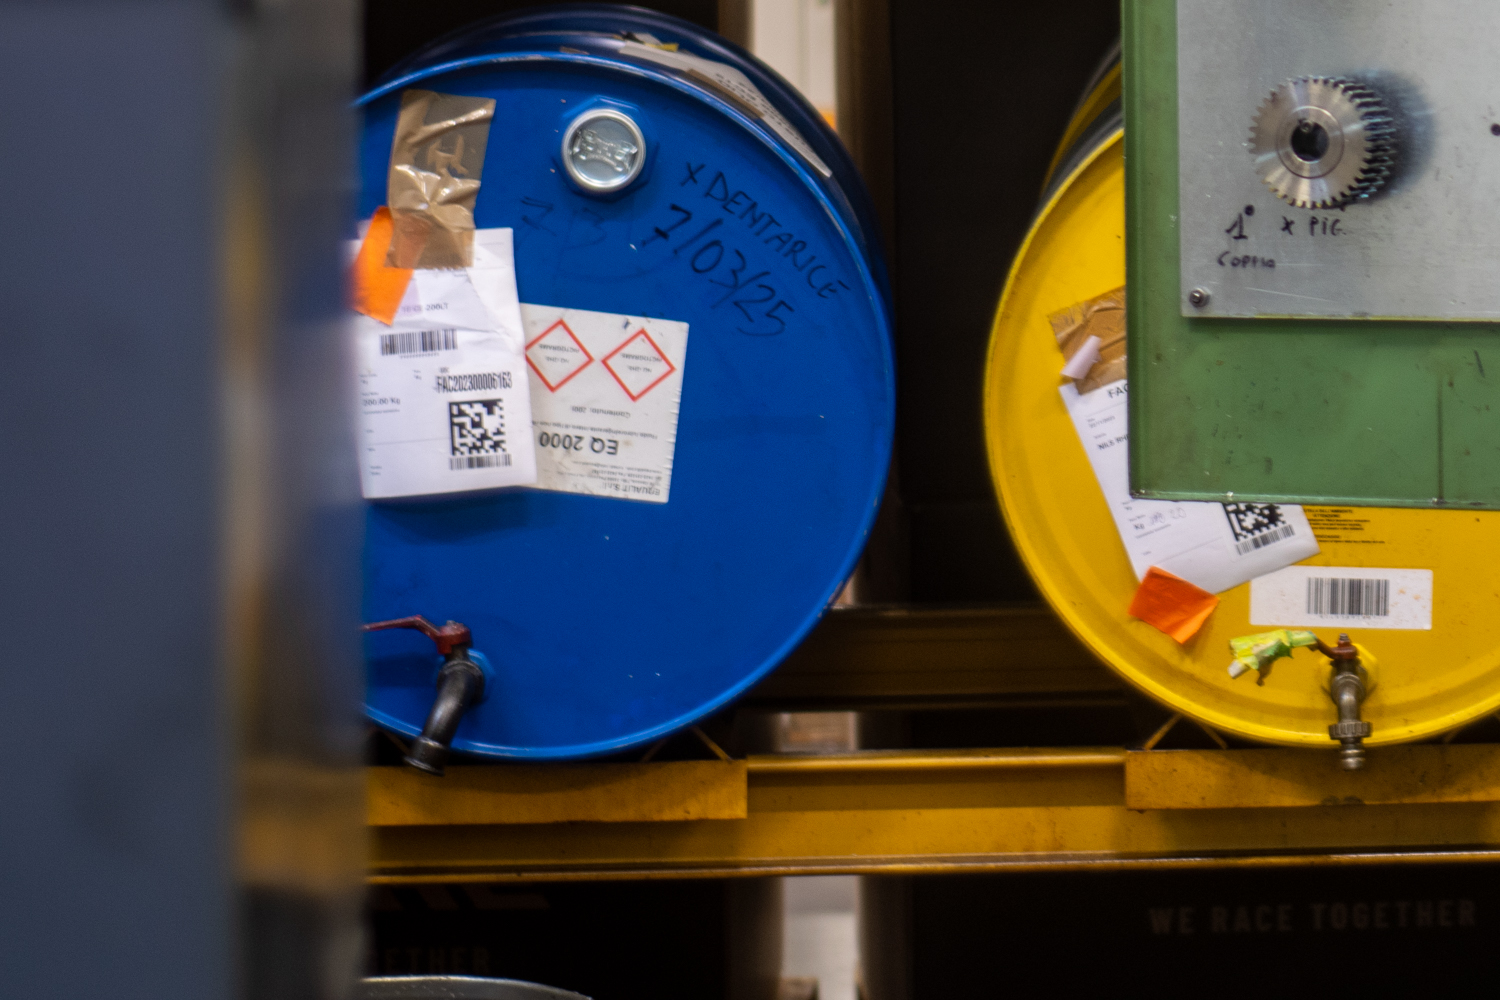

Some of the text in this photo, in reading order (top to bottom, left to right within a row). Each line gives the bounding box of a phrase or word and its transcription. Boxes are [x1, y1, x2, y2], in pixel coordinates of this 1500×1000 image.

[538, 431, 620, 457] EQ 2000
[1148, 899, 1477, 935] WE RACE TOGETHER
